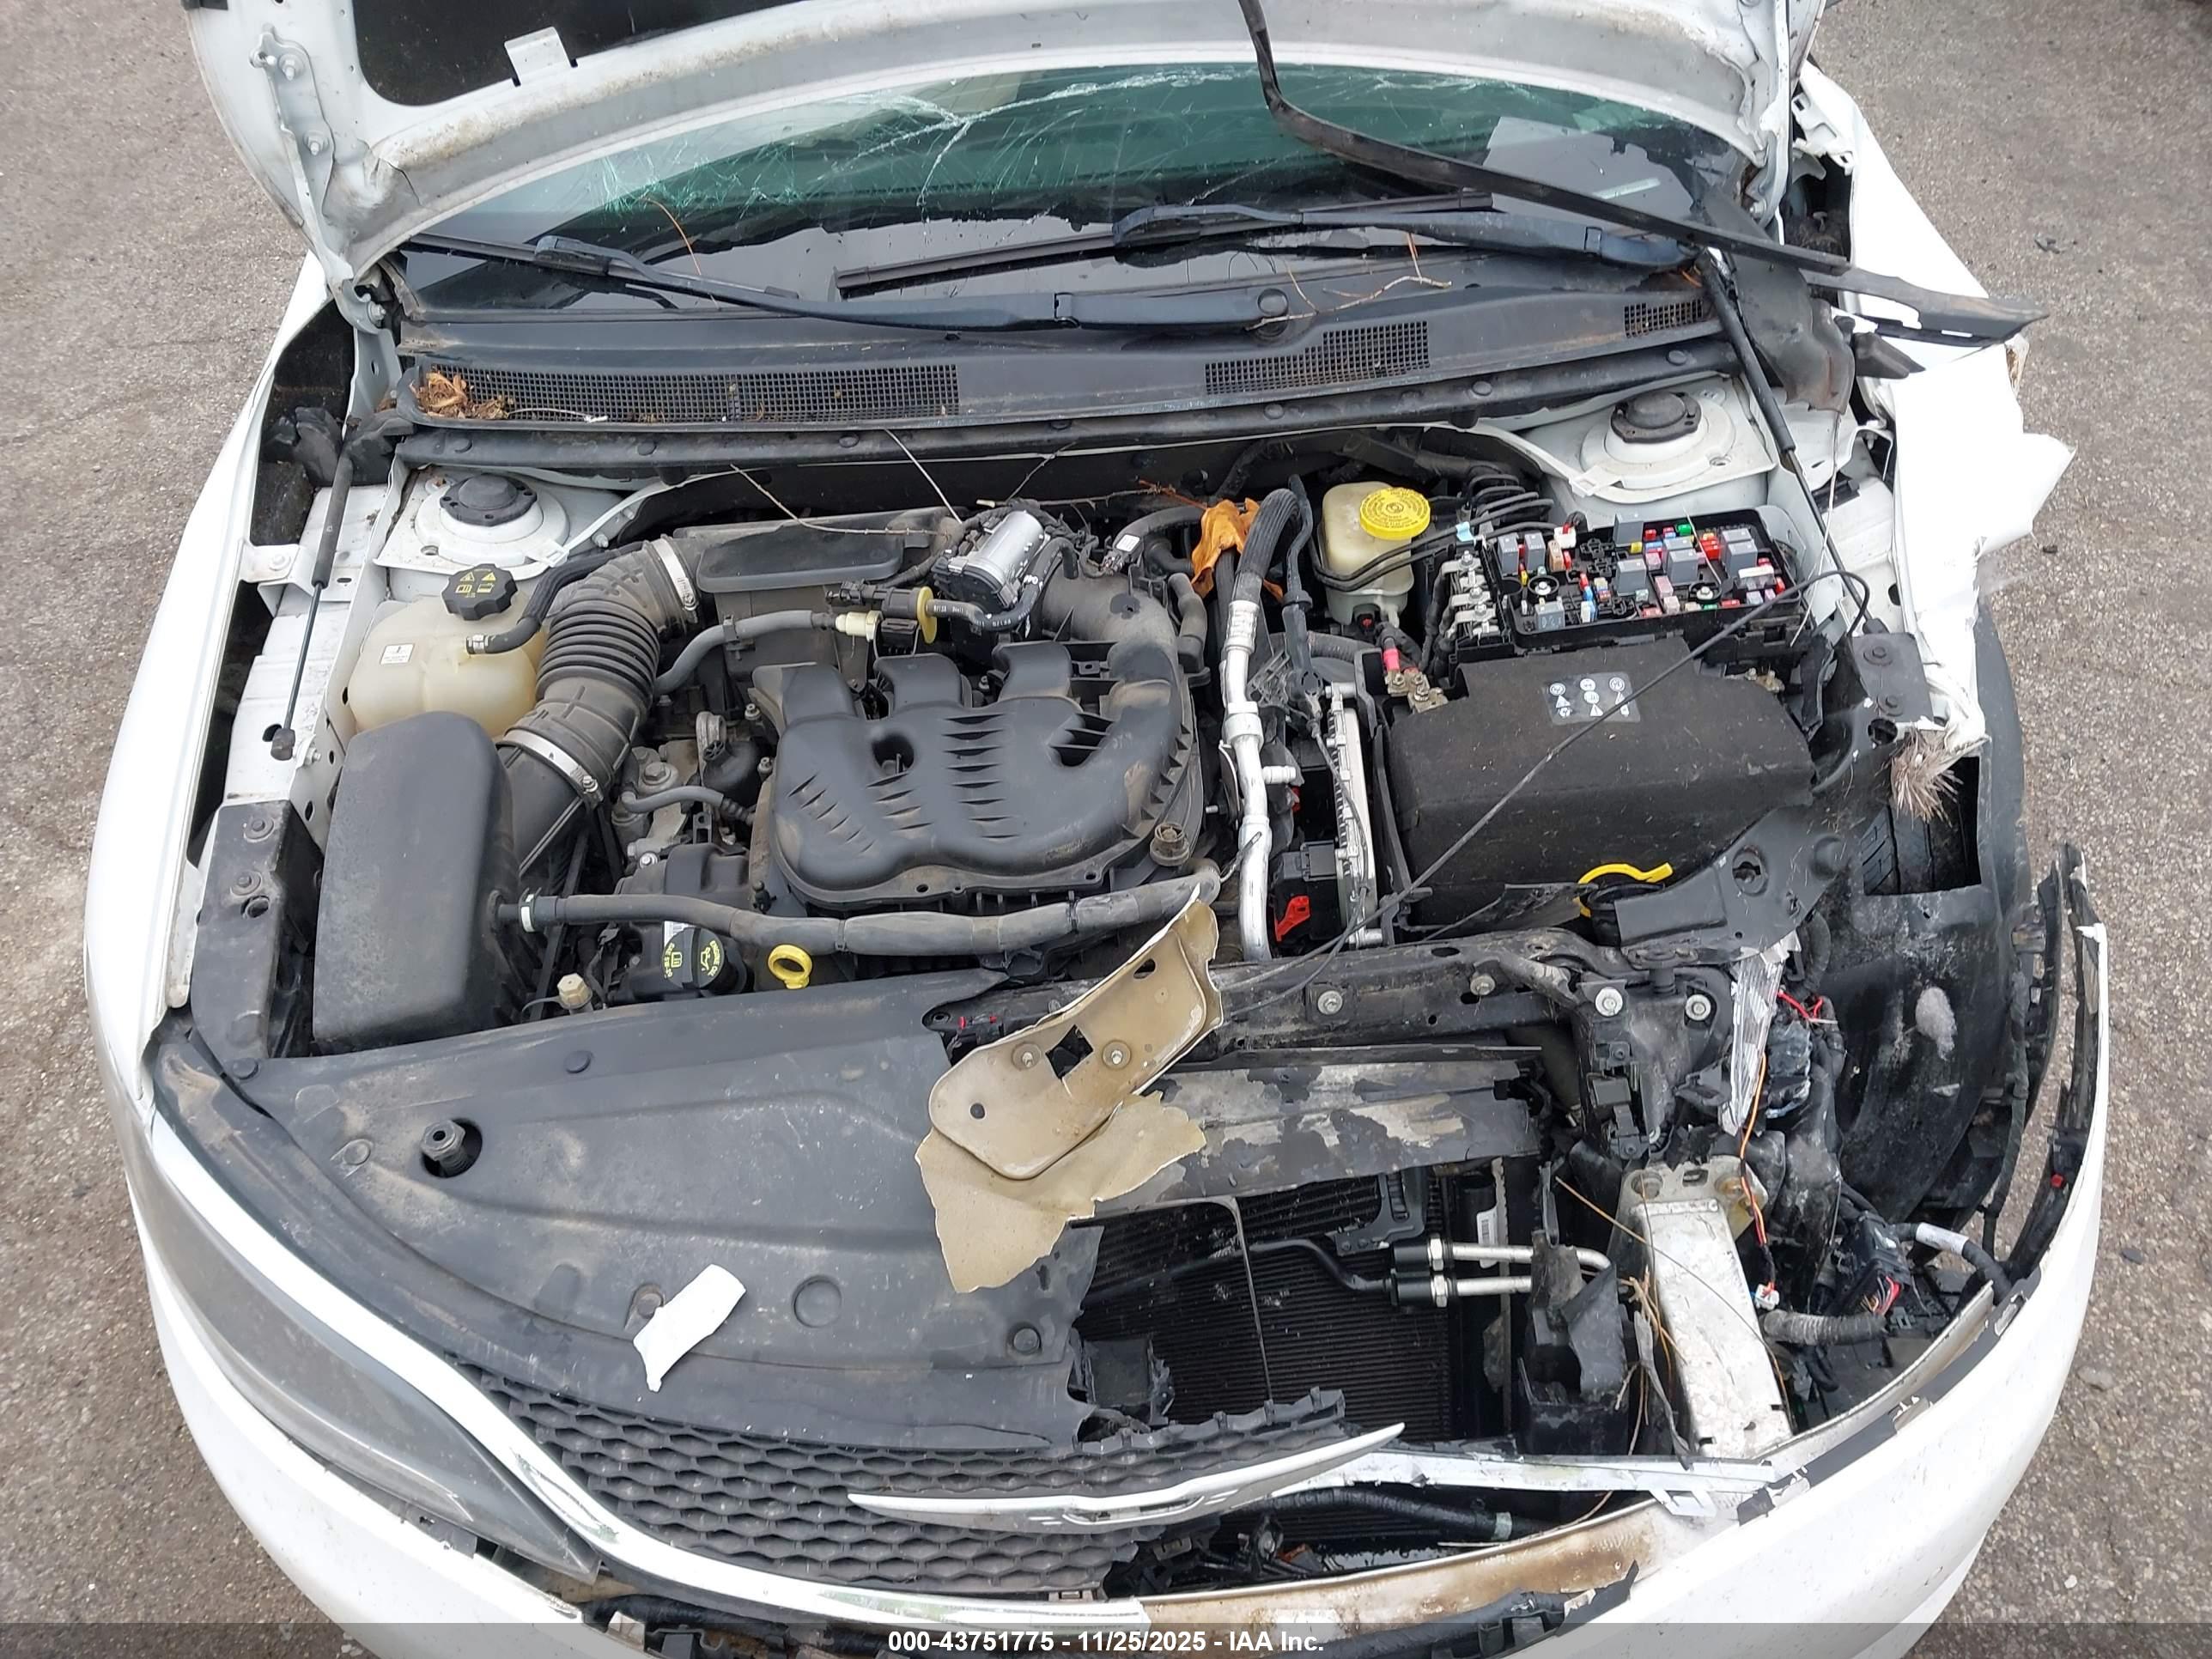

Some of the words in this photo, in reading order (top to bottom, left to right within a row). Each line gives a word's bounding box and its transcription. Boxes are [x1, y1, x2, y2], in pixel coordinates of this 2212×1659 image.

[665, 942, 675, 956] SAE
[709, 940, 720, 965] ENGINE
[708, 966, 718, 977] OIL
